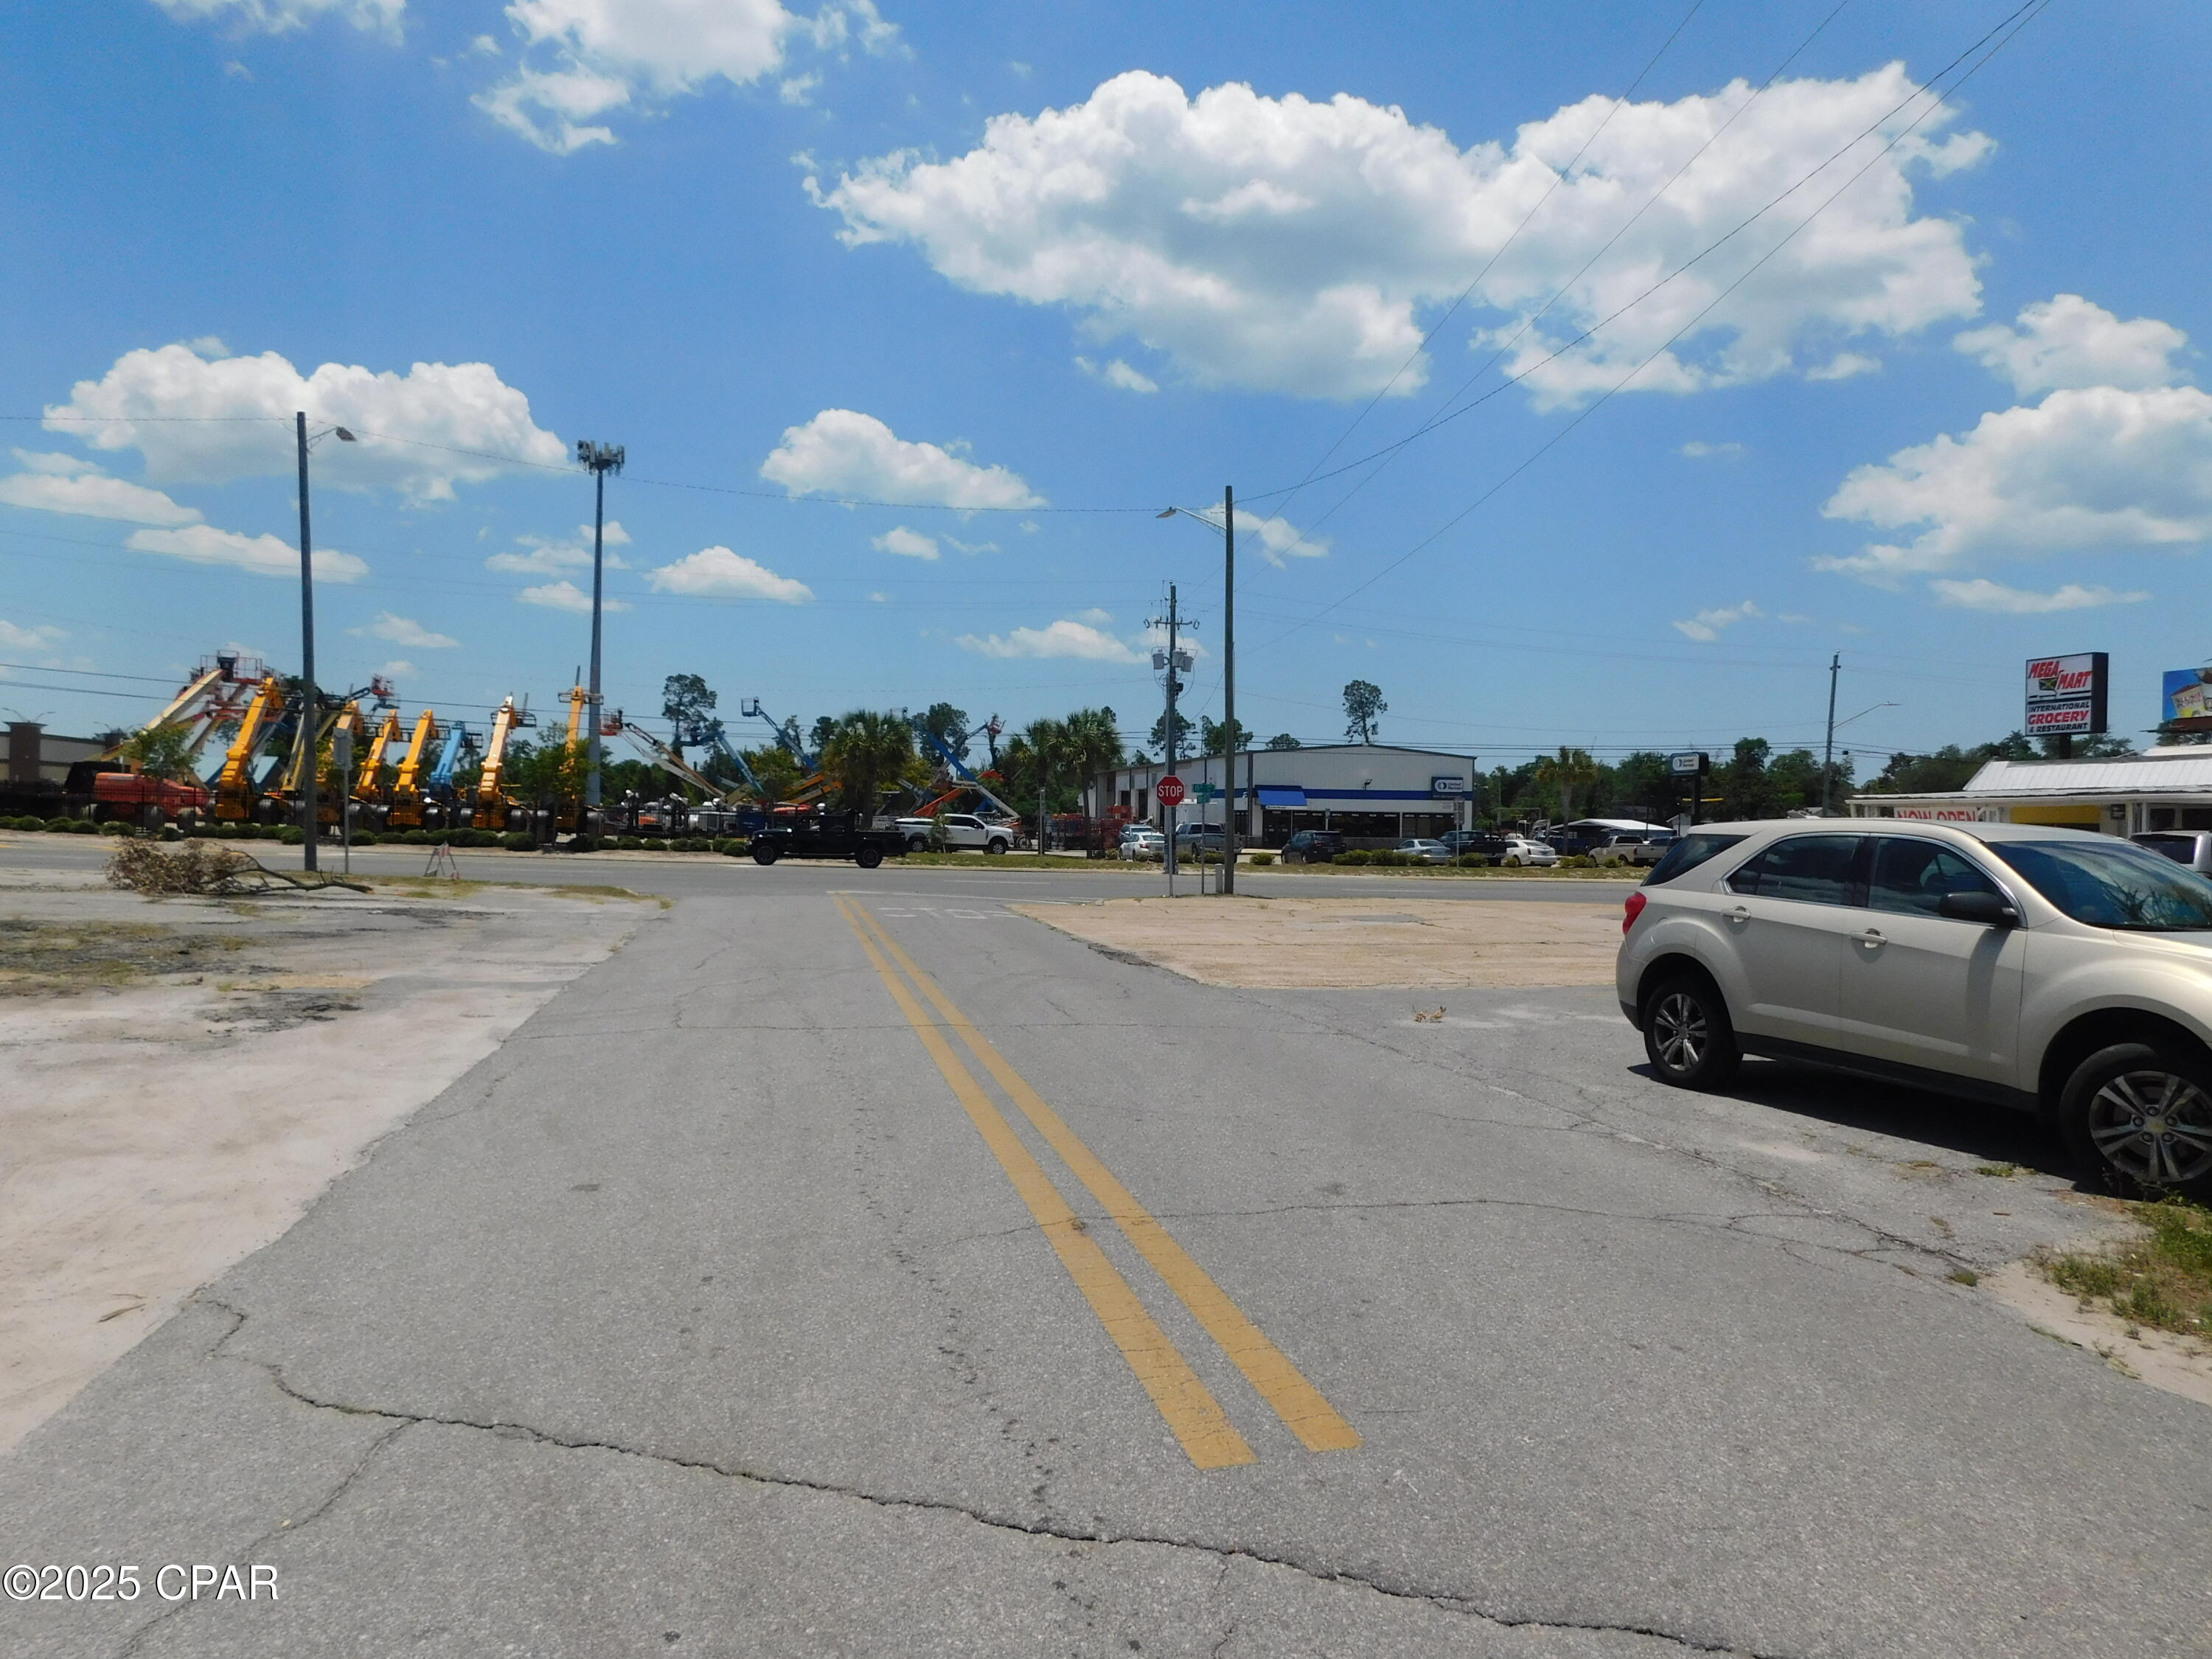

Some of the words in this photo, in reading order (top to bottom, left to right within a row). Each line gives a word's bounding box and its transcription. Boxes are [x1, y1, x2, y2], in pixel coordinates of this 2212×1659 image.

[2028, 661, 2060, 678] MEGA
[2056, 670, 2093, 690] MART
[2028, 701, 2090, 712] INTERNATIONAL
[2028, 710, 2089, 725] GROCERY
[2036, 723, 2088, 732] RESTAURANT
[1158, 785, 1183, 797] STOP
